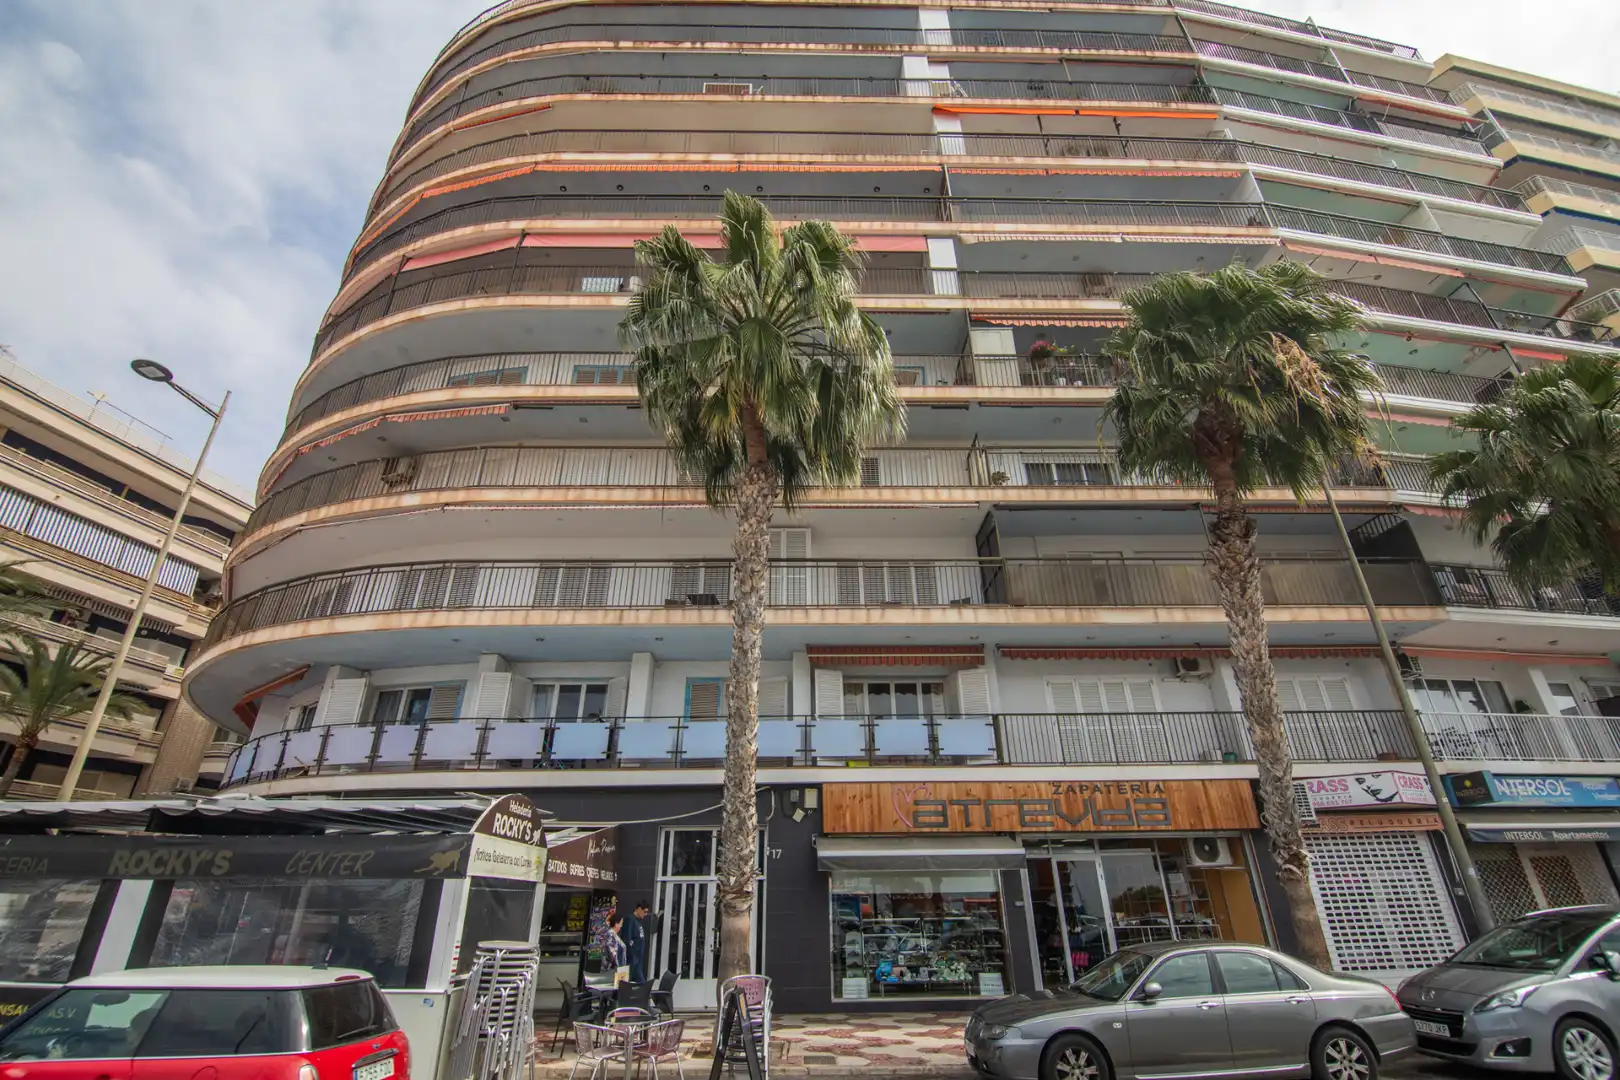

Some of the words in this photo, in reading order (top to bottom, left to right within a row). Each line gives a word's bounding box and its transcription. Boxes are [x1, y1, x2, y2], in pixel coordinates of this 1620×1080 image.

[1306, 778, 1350, 794] RASS
[1398, 774, 1425, 791] CRASS
[1494, 778, 1573, 797] NTERSOL
[492, 812, 533, 841] ROCKY'S
[1320, 818, 1348, 832] ASS
[1503, 831, 1547, 841] INTERSOL
[1552, 831, 1610, 843] Apartamentos
[107, 849, 234, 876] ROCKY'S
[285, 849, 375, 877] CENTER
[547, 859, 568, 874] BATIDOS
